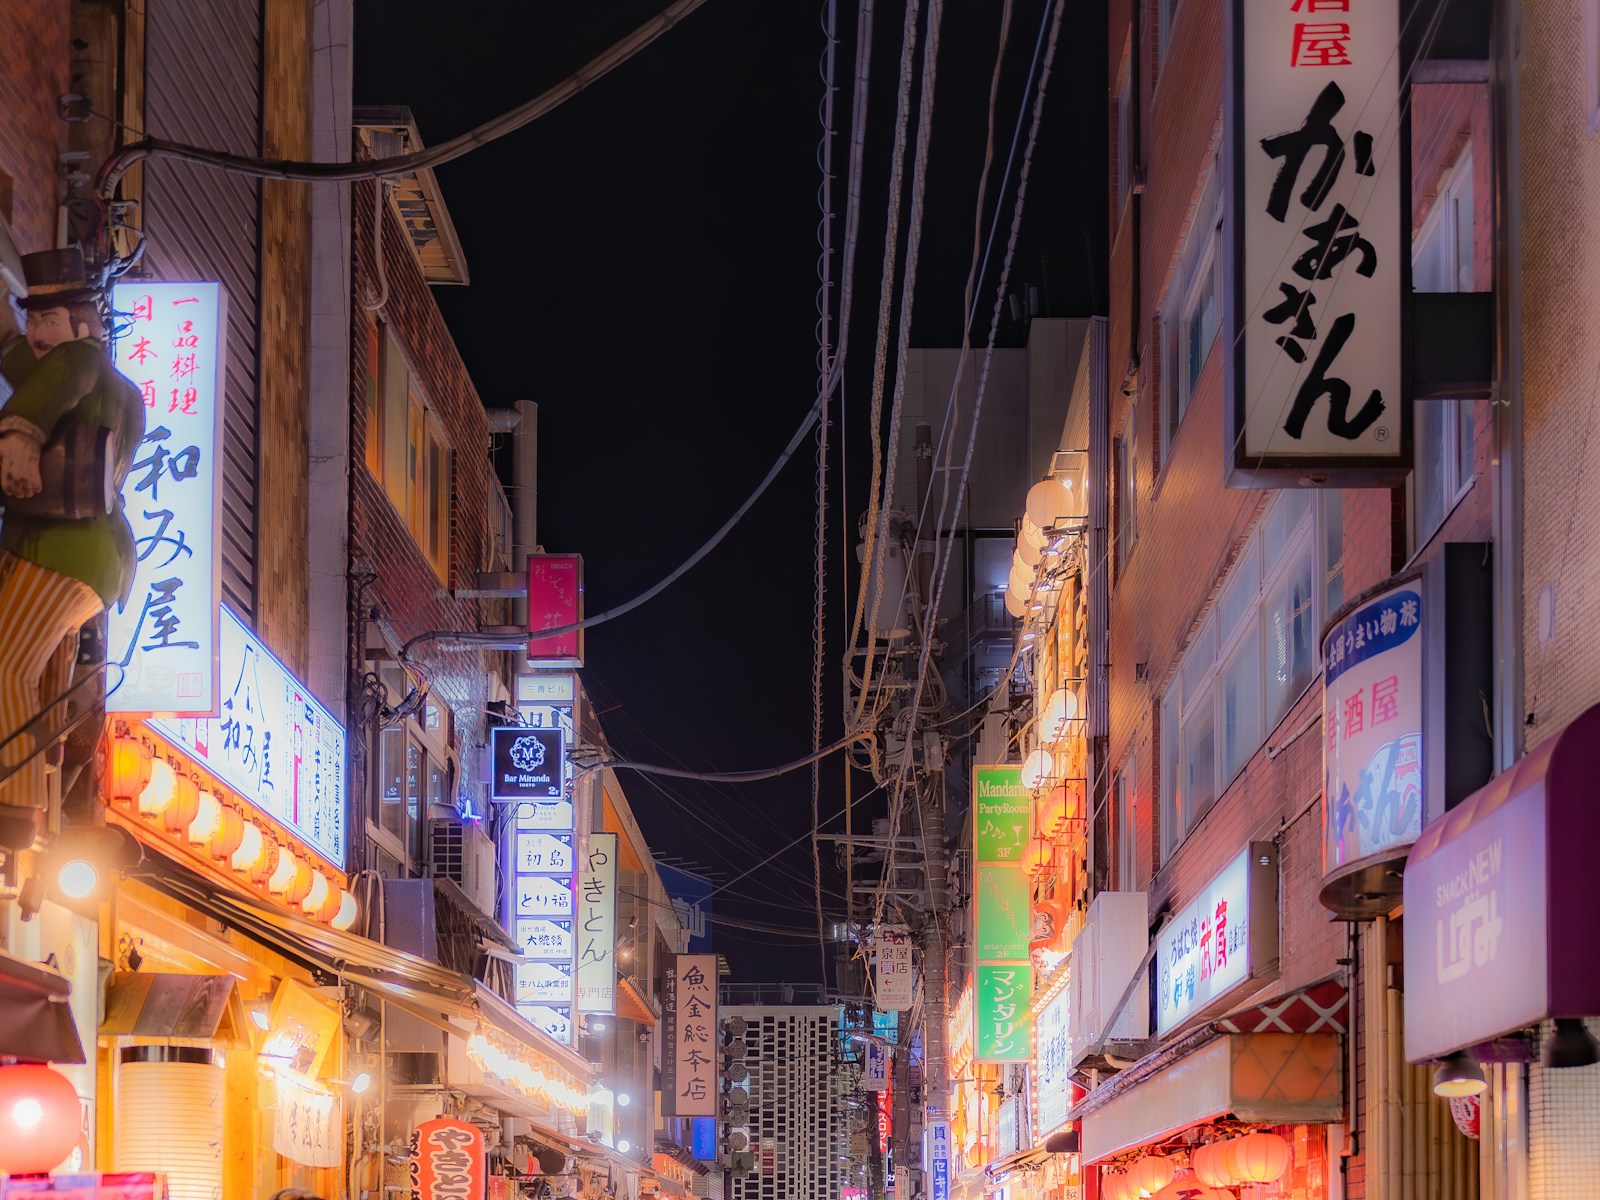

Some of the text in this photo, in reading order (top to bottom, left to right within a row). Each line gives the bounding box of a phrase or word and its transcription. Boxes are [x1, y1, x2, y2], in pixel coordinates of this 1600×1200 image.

[1289, 0, 1353, 68] 屋
[168, 297, 200, 416] 一品料理
[119, 425, 200, 668] 和み屋
[1327, 675, 1399, 752] 居酒屋
[504, 774, 550, 783] Bar Miranda
[548, 787, 560, 795] 2F
[1326, 741, 1417, 844] あさん
[525, 849, 564, 866] 初島
[997, 847, 1012, 858] 3F
[1436, 838, 1502, 907] SNACK NEW
[521, 893, 568, 908] とり福
[560, 921, 570, 929] 1F
[581, 848, 609, 962] やきとん
[526, 934, 563, 947] 大統領
[996, 950, 1011, 959] 2F
[1170, 916, 1198, 967] ろばた焼
[1200, 898, 1228, 983] 武蔵
[578, 986, 613, 999] 専門店
[992, 970, 1017, 1055] マンダリン
[681, 965, 711, 1101] 魚金総本店
